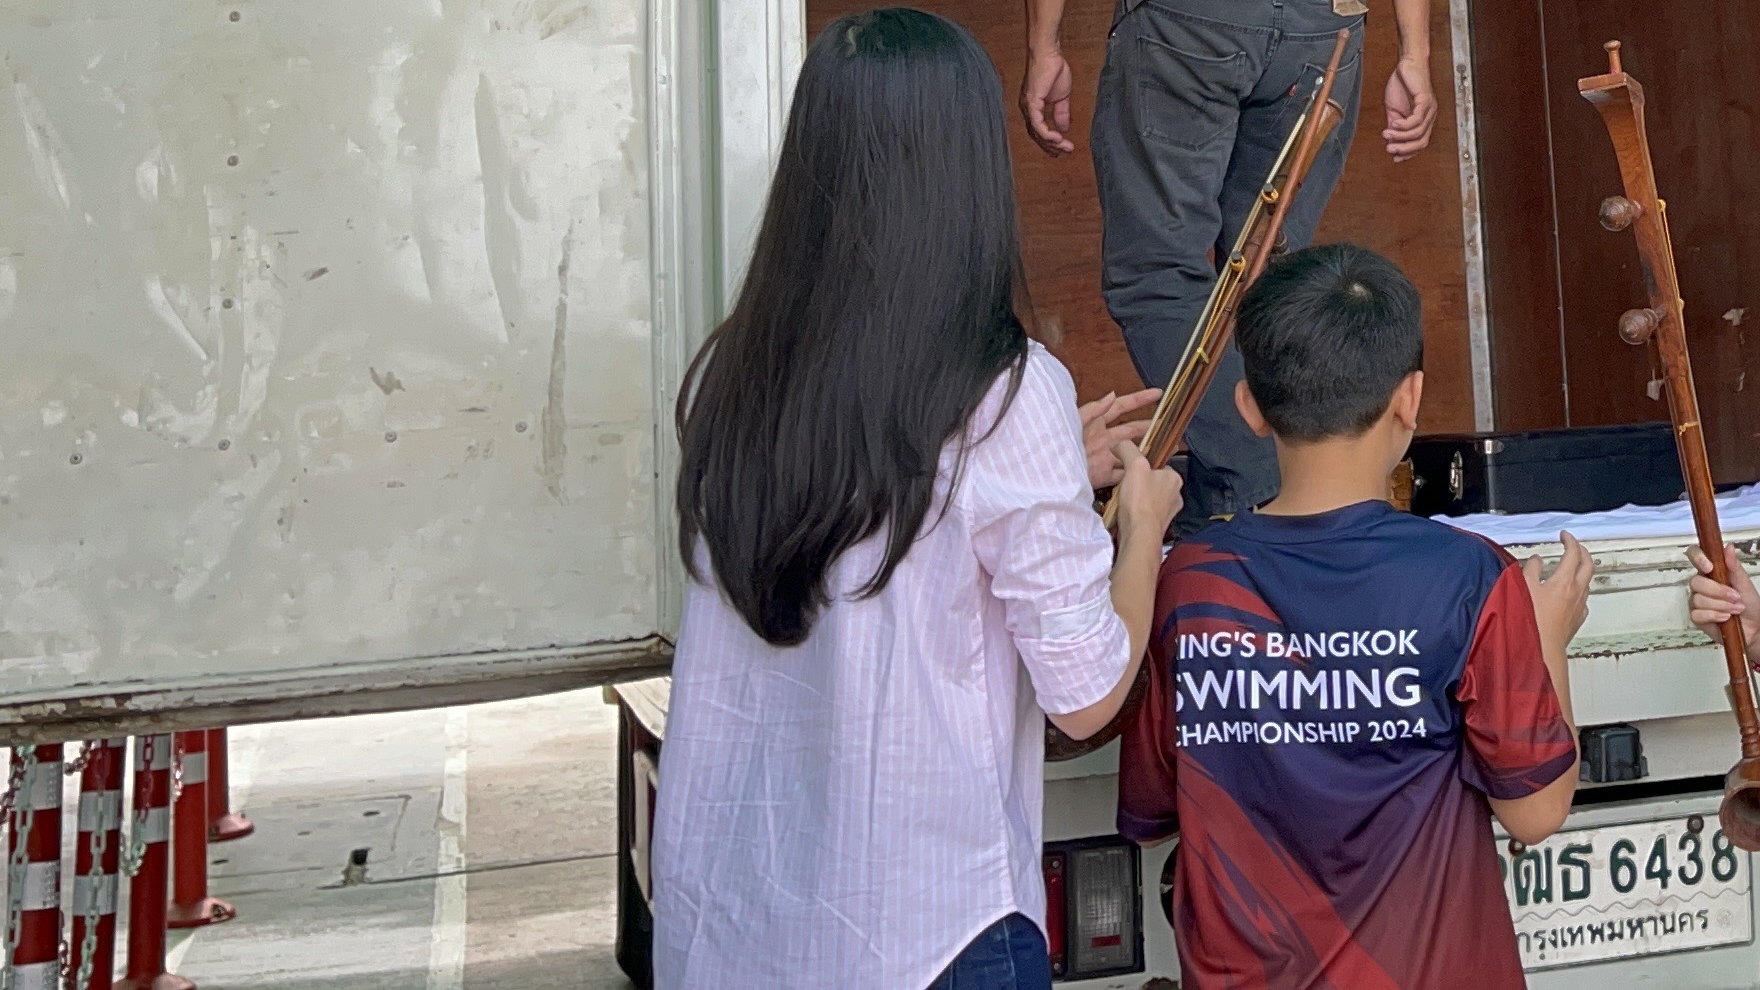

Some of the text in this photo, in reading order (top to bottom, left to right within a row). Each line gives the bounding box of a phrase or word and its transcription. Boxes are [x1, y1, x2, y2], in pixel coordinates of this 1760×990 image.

[1175, 629, 1420, 660] ING'S BANGKOK
[1176, 718, 1427, 747] HAMPIONSHIP 2024
[1609, 828, 1739, 894] 6438
[1516, 909, 1709, 960] กรุงเทพมหานคร
